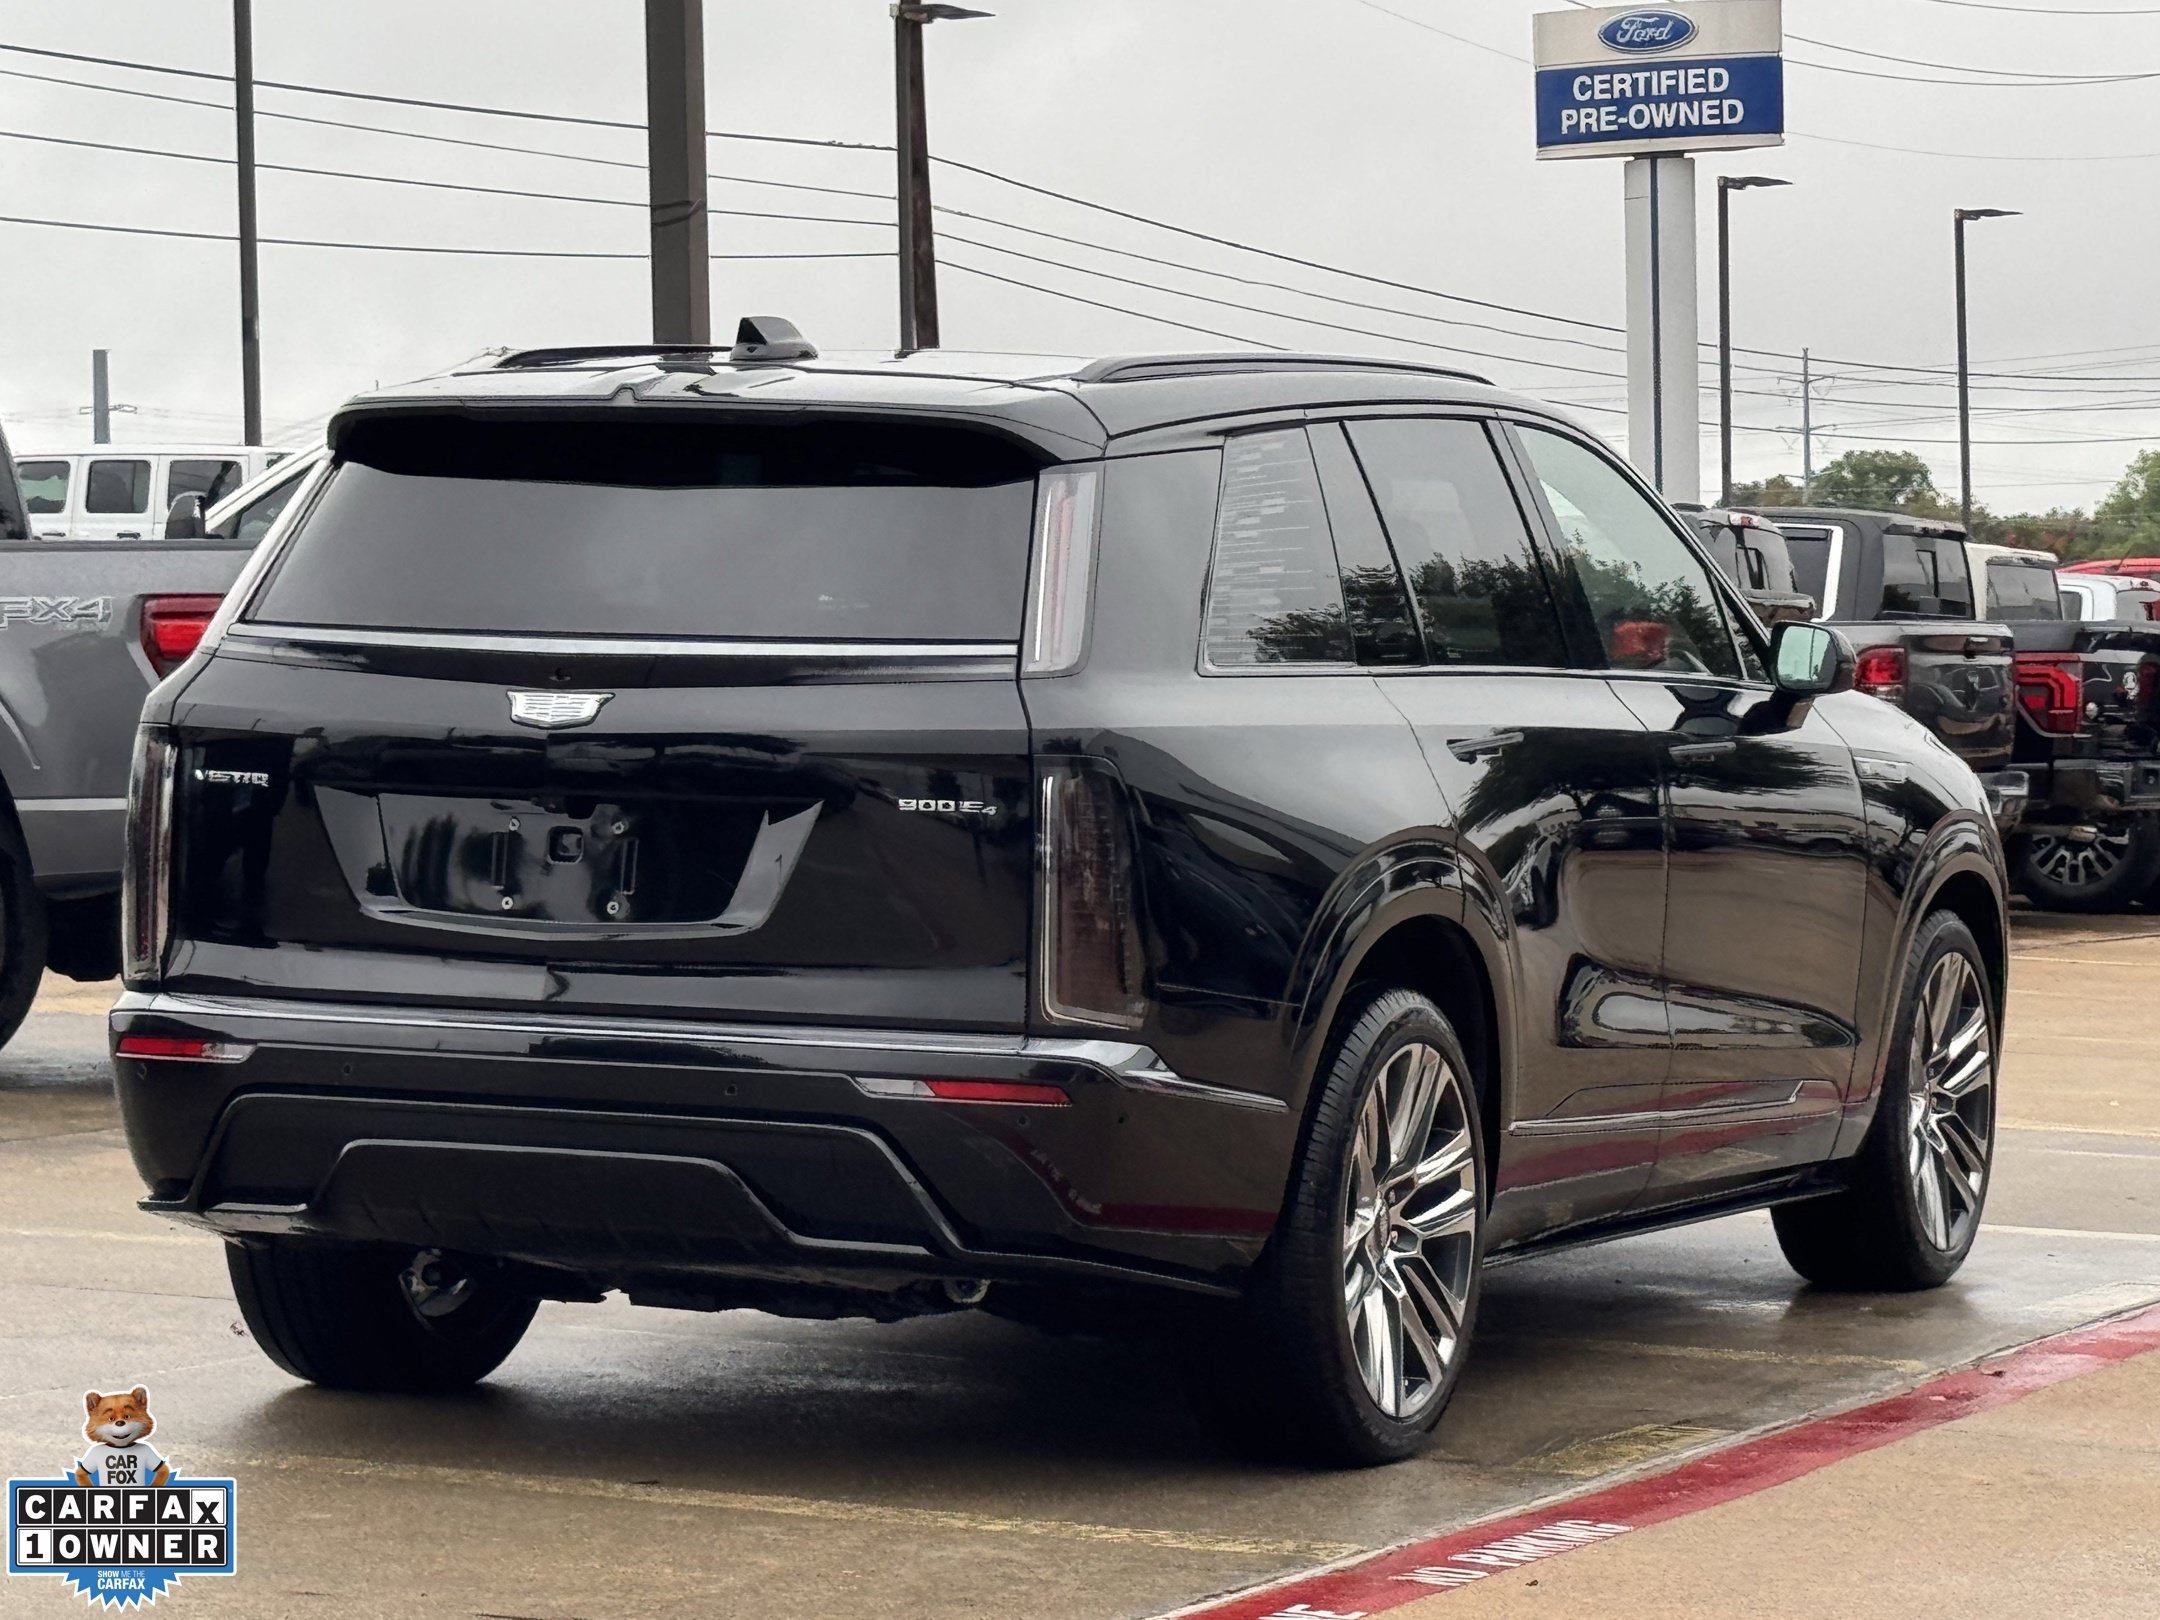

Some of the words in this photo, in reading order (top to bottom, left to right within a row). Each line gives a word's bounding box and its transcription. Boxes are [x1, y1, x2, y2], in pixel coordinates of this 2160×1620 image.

[1617, 17, 1674, 42] Ford
[1573, 67, 1729, 101] CERTIFIED
[1561, 99, 1744, 134] PRE-OWNED
[0, 596, 114, 630] FX4
[1388, 1566, 1490, 1587] NO
[1447, 1520, 1634, 1567] PARKING
